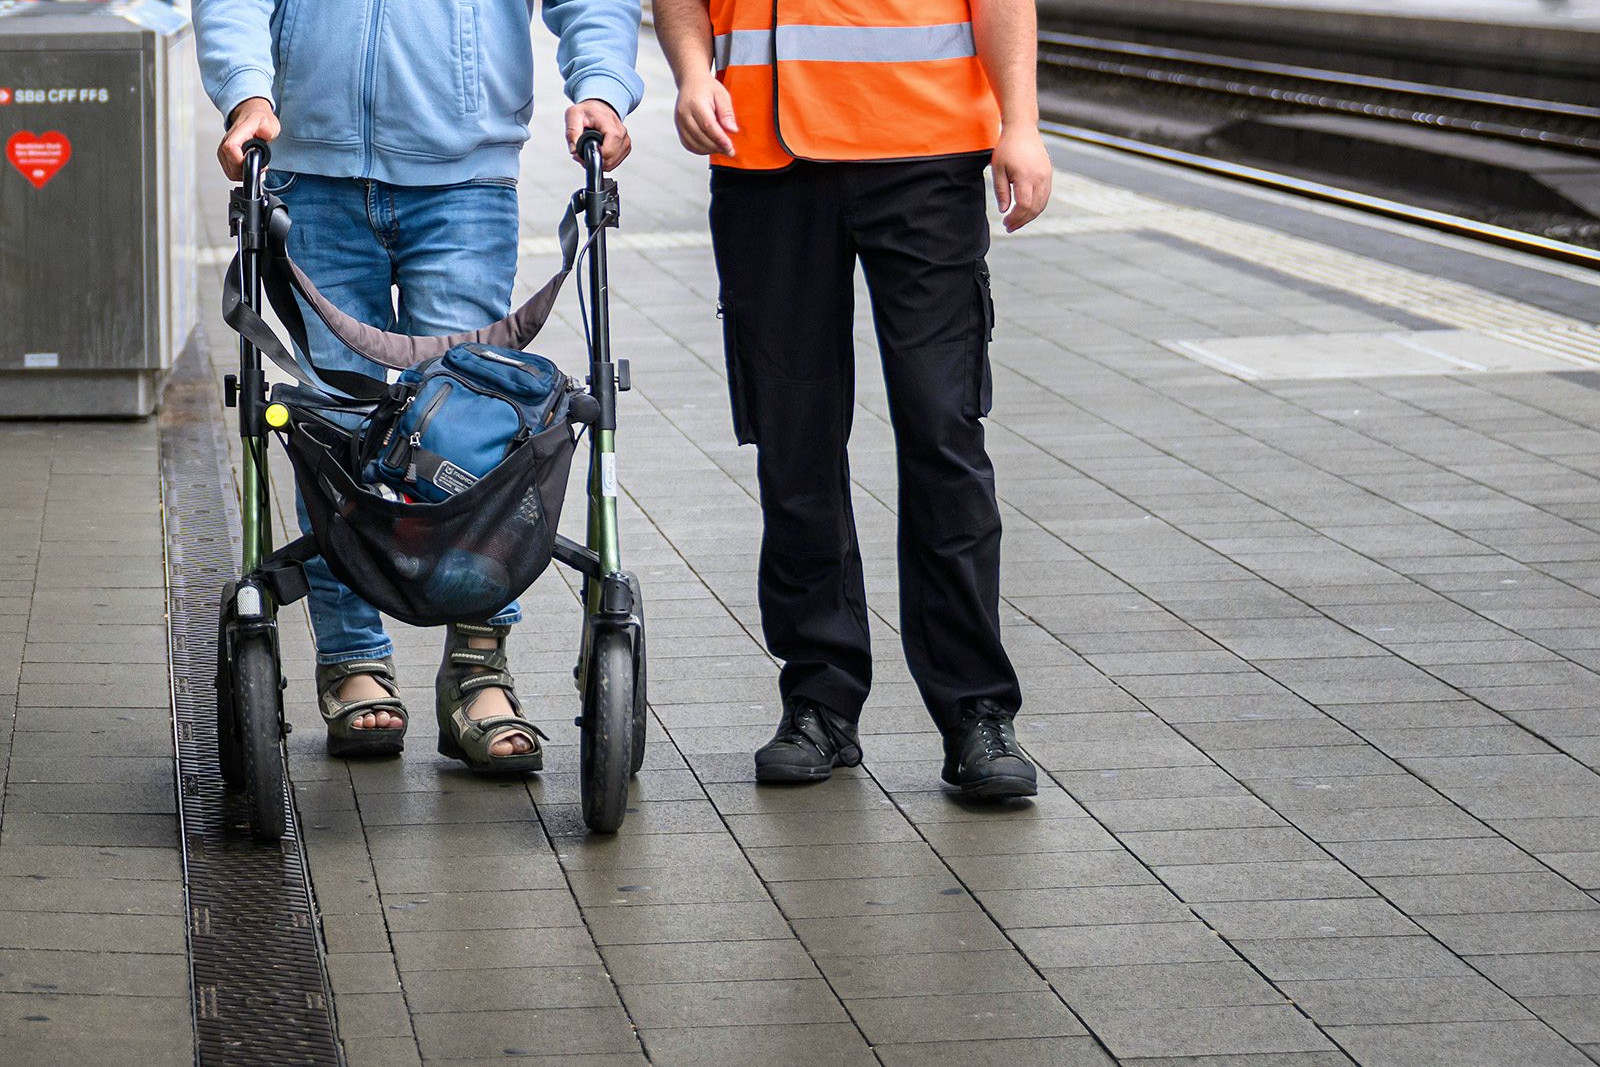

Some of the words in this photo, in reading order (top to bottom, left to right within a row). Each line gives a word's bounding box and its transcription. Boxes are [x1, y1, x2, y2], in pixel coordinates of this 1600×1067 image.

[15, 88, 45, 104] SBB
[48, 88, 77, 103] CFF
[79, 87, 109, 103] FFS
